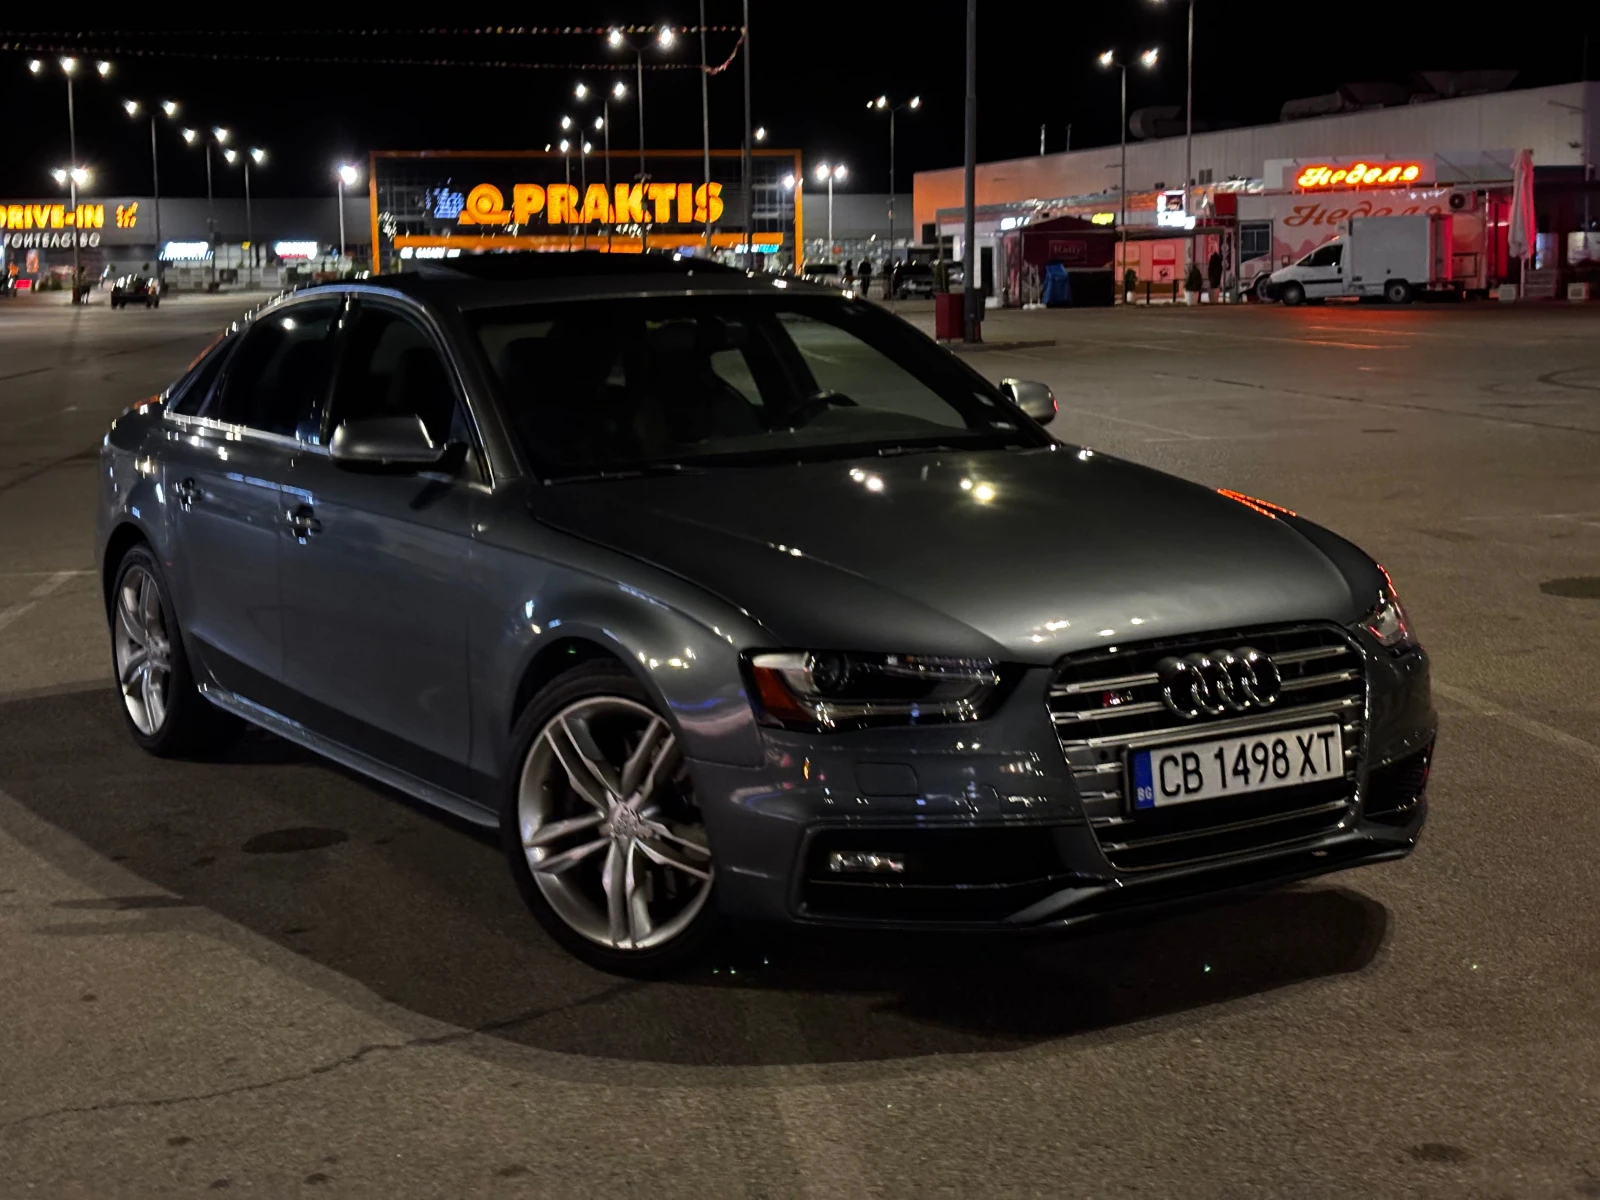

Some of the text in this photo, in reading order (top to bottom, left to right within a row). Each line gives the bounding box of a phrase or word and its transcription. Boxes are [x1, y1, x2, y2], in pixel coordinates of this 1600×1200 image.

[513, 182, 724, 224] PRAKTIS
[1159, 731, 1335, 797] CB 1498 XT
[1137, 786, 1152, 801] BG
